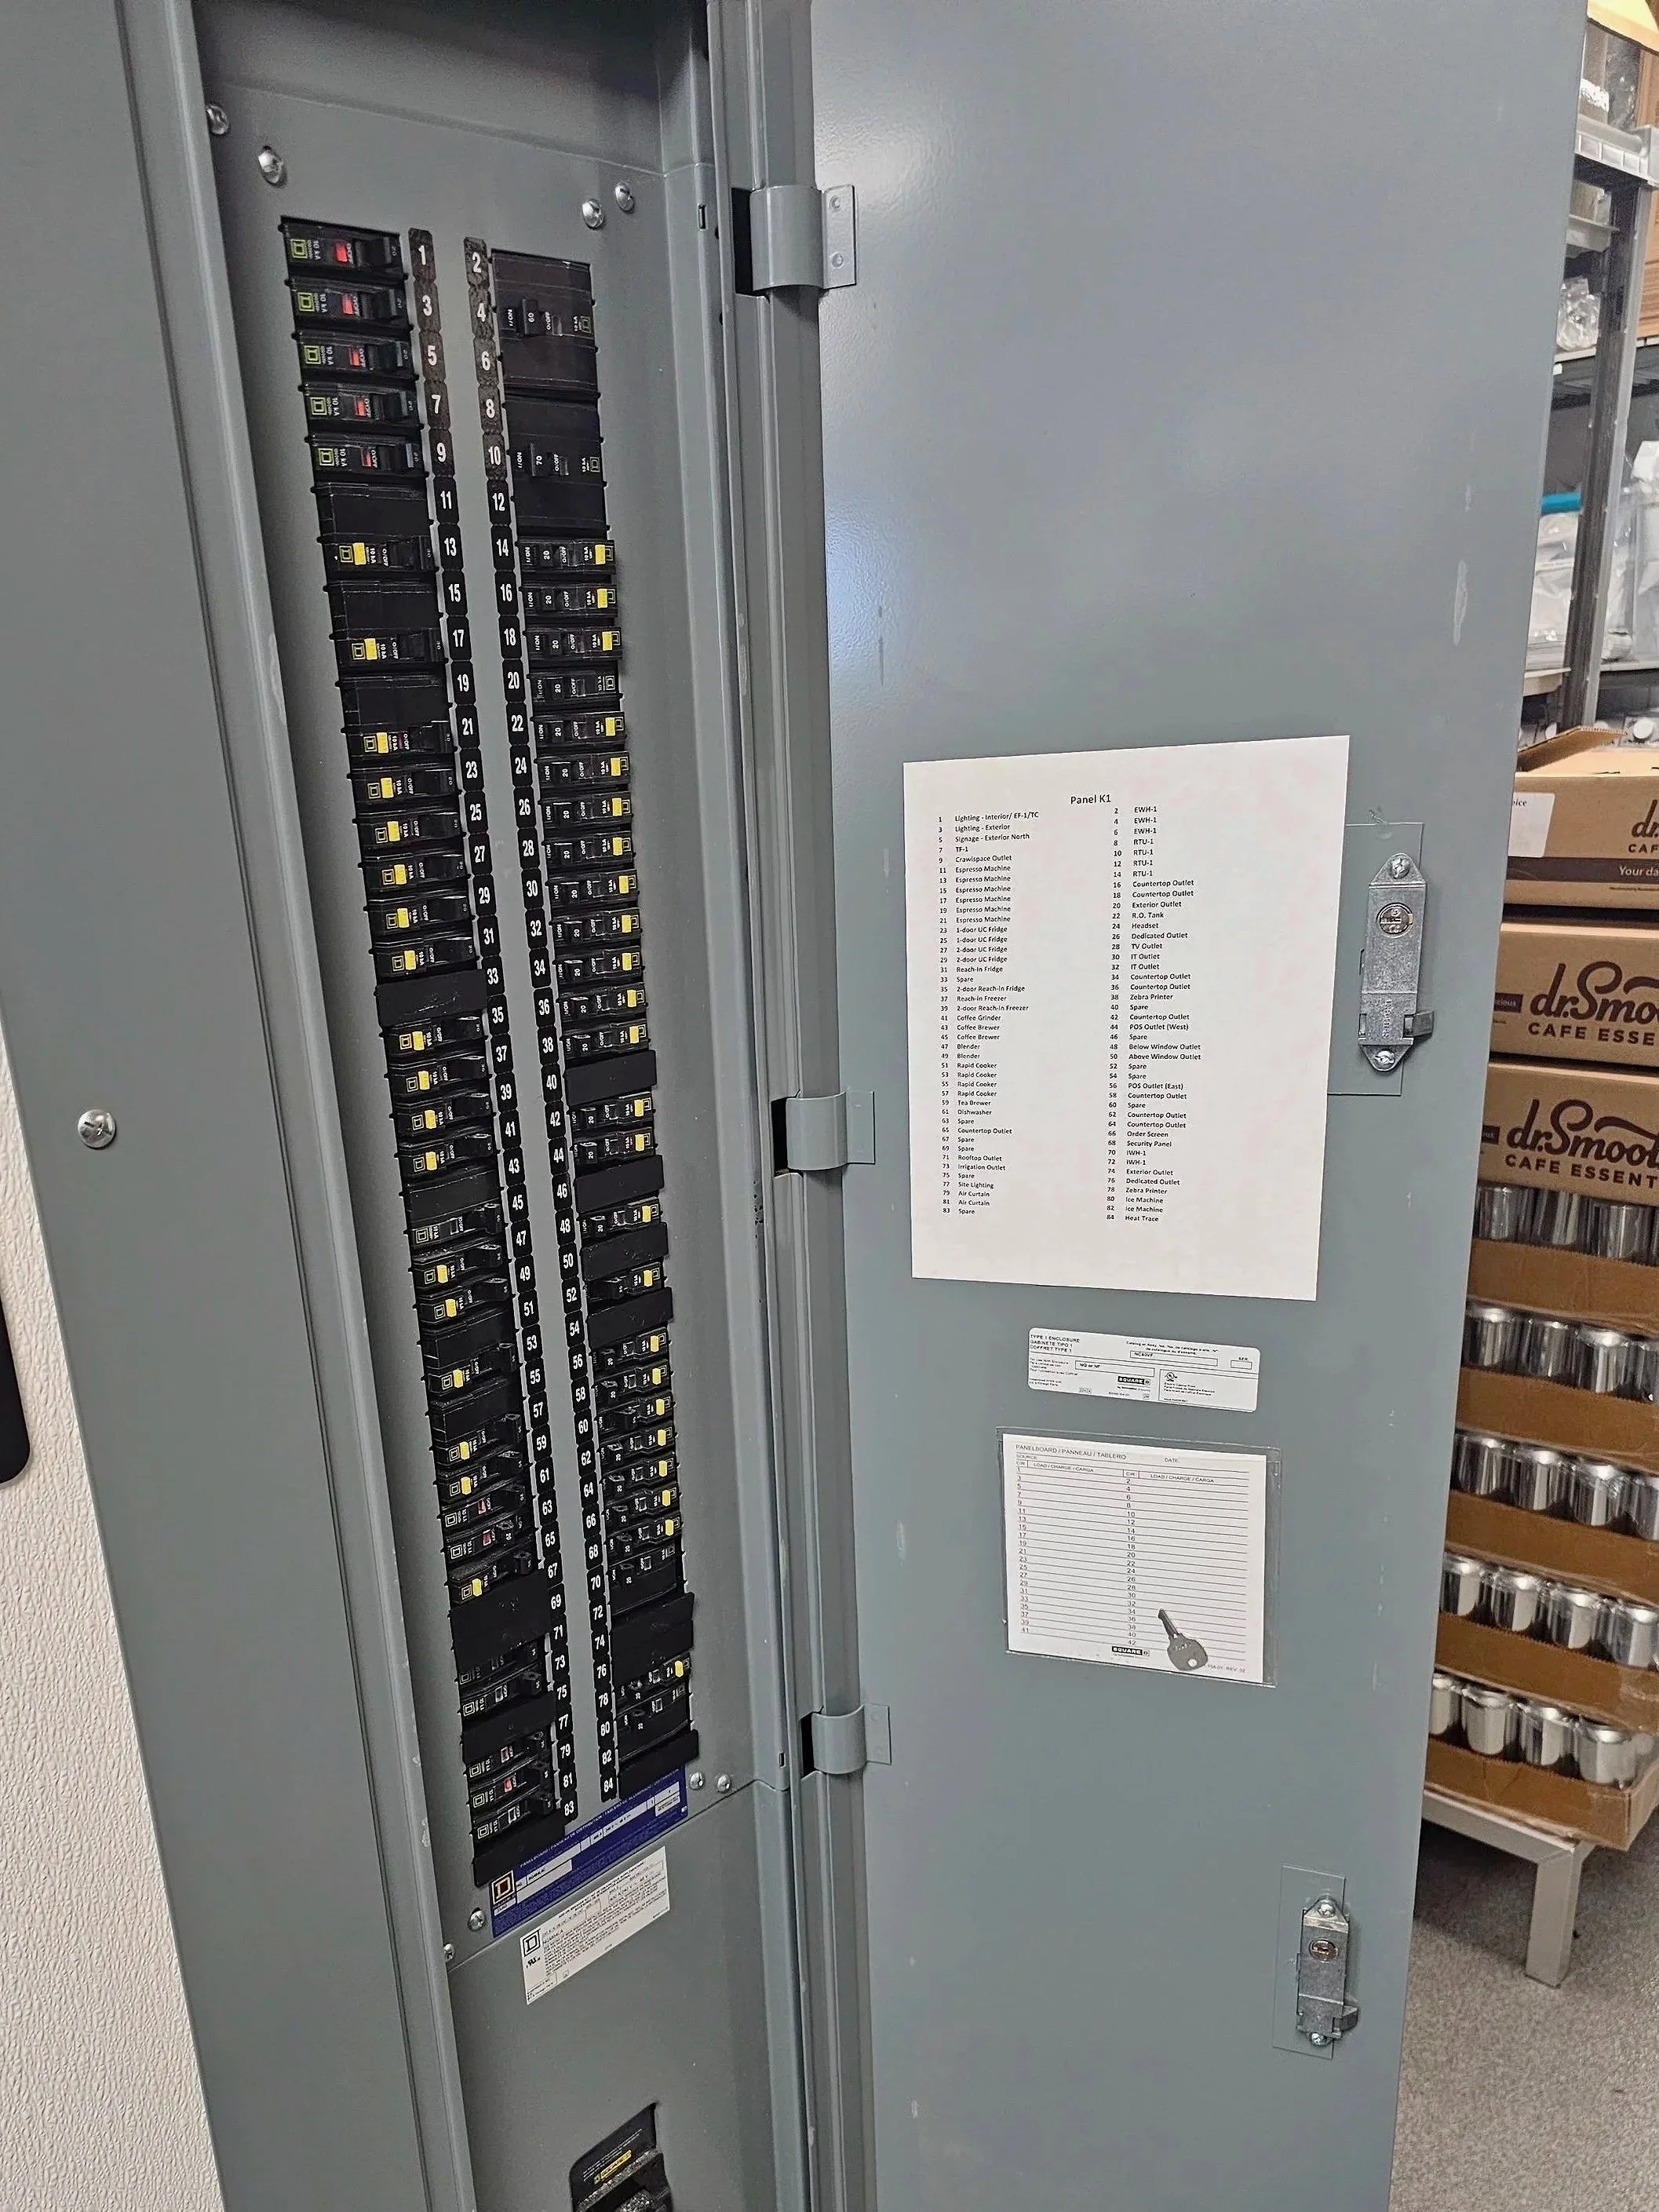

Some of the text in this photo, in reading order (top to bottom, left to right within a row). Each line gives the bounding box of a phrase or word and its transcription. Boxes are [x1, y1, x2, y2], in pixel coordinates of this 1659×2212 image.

[419, 246, 425, 265] 1
[472, 252, 481, 272] 2
[423, 295, 432, 316] 3
[477, 303, 486, 322] 4
[428, 345, 436, 365] 5
[482, 351, 490, 370] 6
[432, 395, 440, 414] 7
[487, 399, 494, 418] 8
[437, 443, 446, 462] 9
[488, 446, 501, 465] 10
[441, 491, 451, 509] 11
[493, 493, 505, 511] 12
[444, 538, 456, 556] 13
[543, 550, 550, 560] 20
[501, 584, 512, 601] 16
[552, 640, 559, 649] 20
[458, 674, 469, 692] 19
[512, 715, 523, 732] 22
[1071, 794, 1111, 805] Panel K1
[470, 804, 481, 820] 25
[523, 840, 534, 856] 28
[1619, 866, 1642, 877] Your
[484, 928, 494, 944] 31
[534, 959, 545, 976] 34
[1528, 1022, 1587, 1039] CAFE
[496, 1046, 507, 1062] 37
[547, 1075, 556, 1090] 40
[509, 1159, 520, 1174] 43
[1504, 1155, 1560, 1174] CAFE
[557, 1183, 567, 1198] 46
[520, 1266, 530, 1281] 49
[567, 1287, 577, 1302] 52
[531, 1369, 540, 1384] 55
[576, 1387, 585, 1402] 58
[1015, 1444, 1056, 1453] PANELBOARD
[540, 1468, 549, 1483] 61
[584, 1482, 593, 1497] 64
[549, 1563, 557, 1578] 67
[591, 1575, 600, 1590] 70
[555, 1655, 565, 1670] 73
[597, 1664, 607, 1678] 76
[560, 1744, 570, 1758] 79
[603, 1750, 611, 1765] 82
